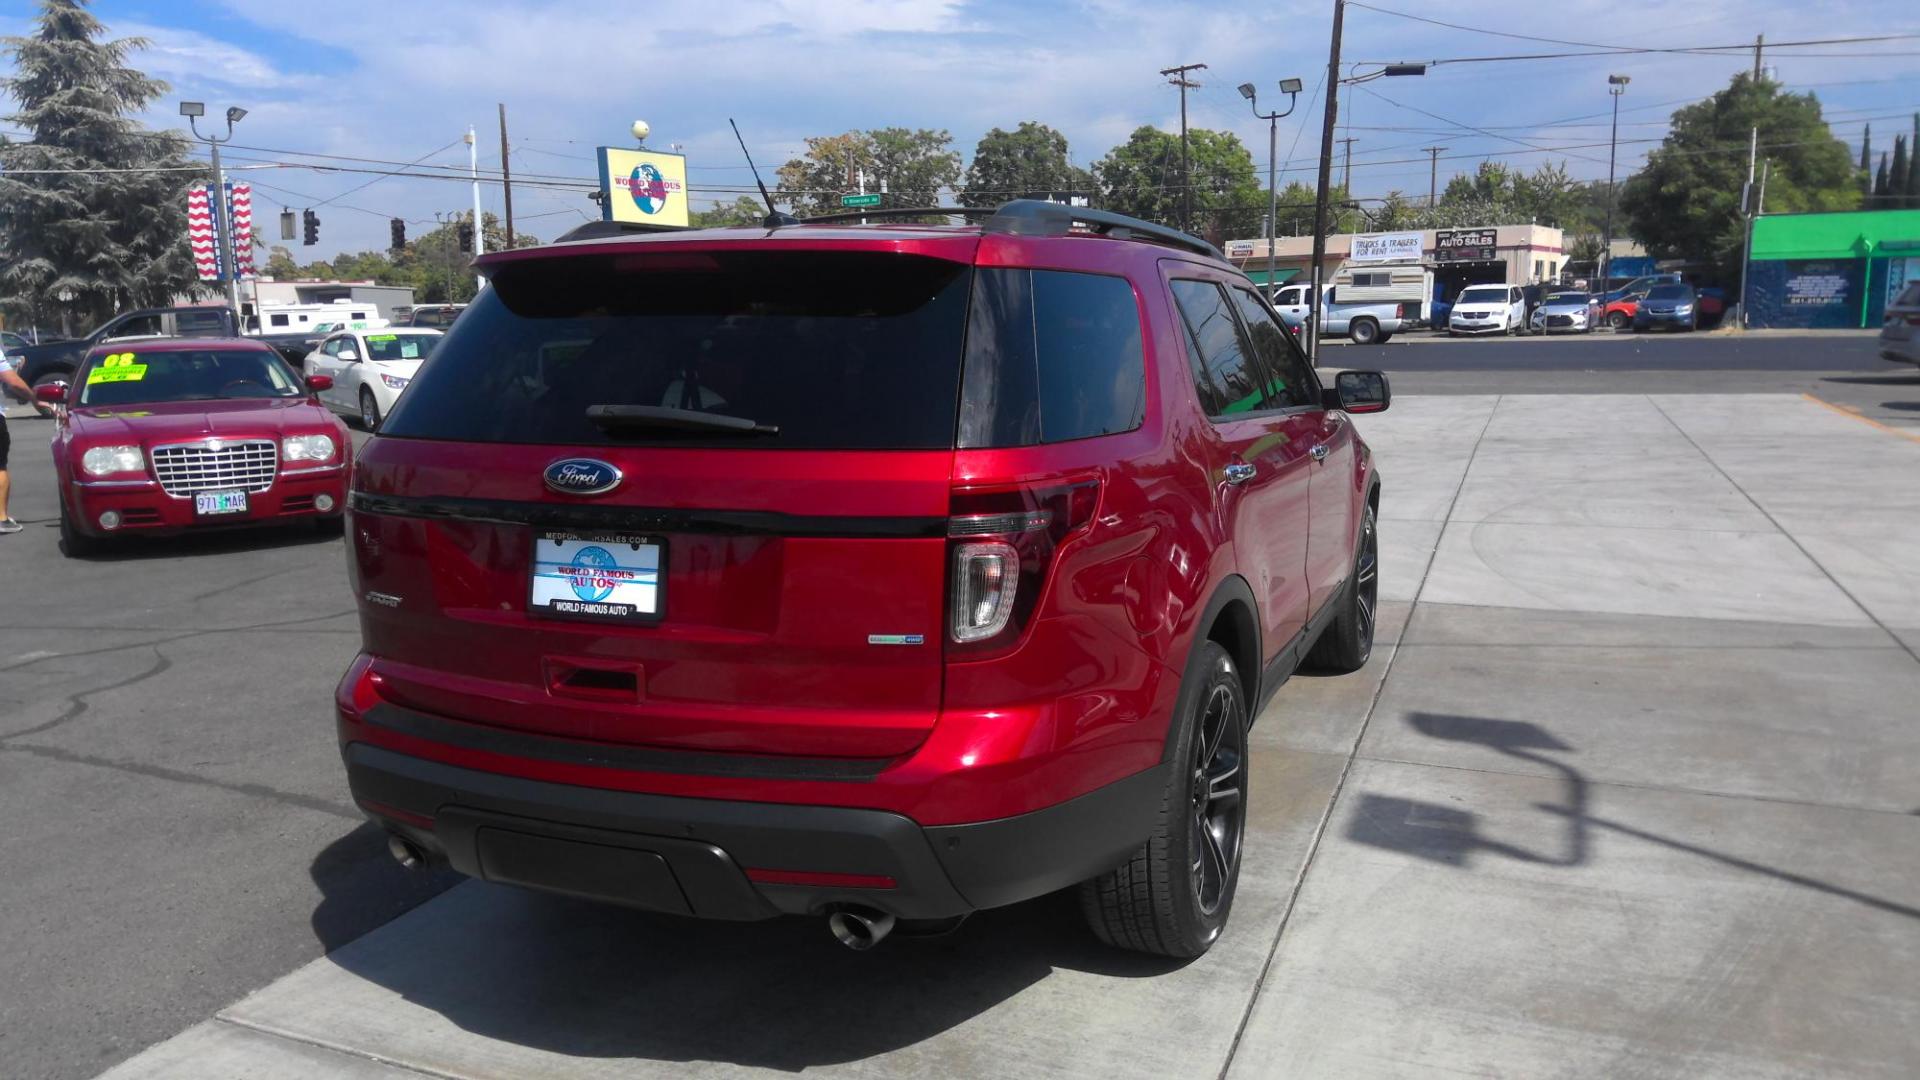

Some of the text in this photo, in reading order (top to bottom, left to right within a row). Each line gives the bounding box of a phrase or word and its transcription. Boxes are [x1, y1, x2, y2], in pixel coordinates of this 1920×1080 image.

[211, 213, 222, 274] FINANCE
[1356, 240, 1379, 248] TRUCKS
[1389, 238, 1418, 247] TRAILERS
[1440, 236, 1493, 248] AUTO SALES
[1356, 249, 1369, 257] FOR
[1372, 247, 1387, 256] RENT
[558, 463, 600, 486] Ford
[198, 494, 245, 510] 971 MAR
[557, 566, 635, 580] WORLD FAMOUS
[572, 577, 616, 589] AUTOS
[556, 601, 628, 617] WORLD FAMOUS AUTO
